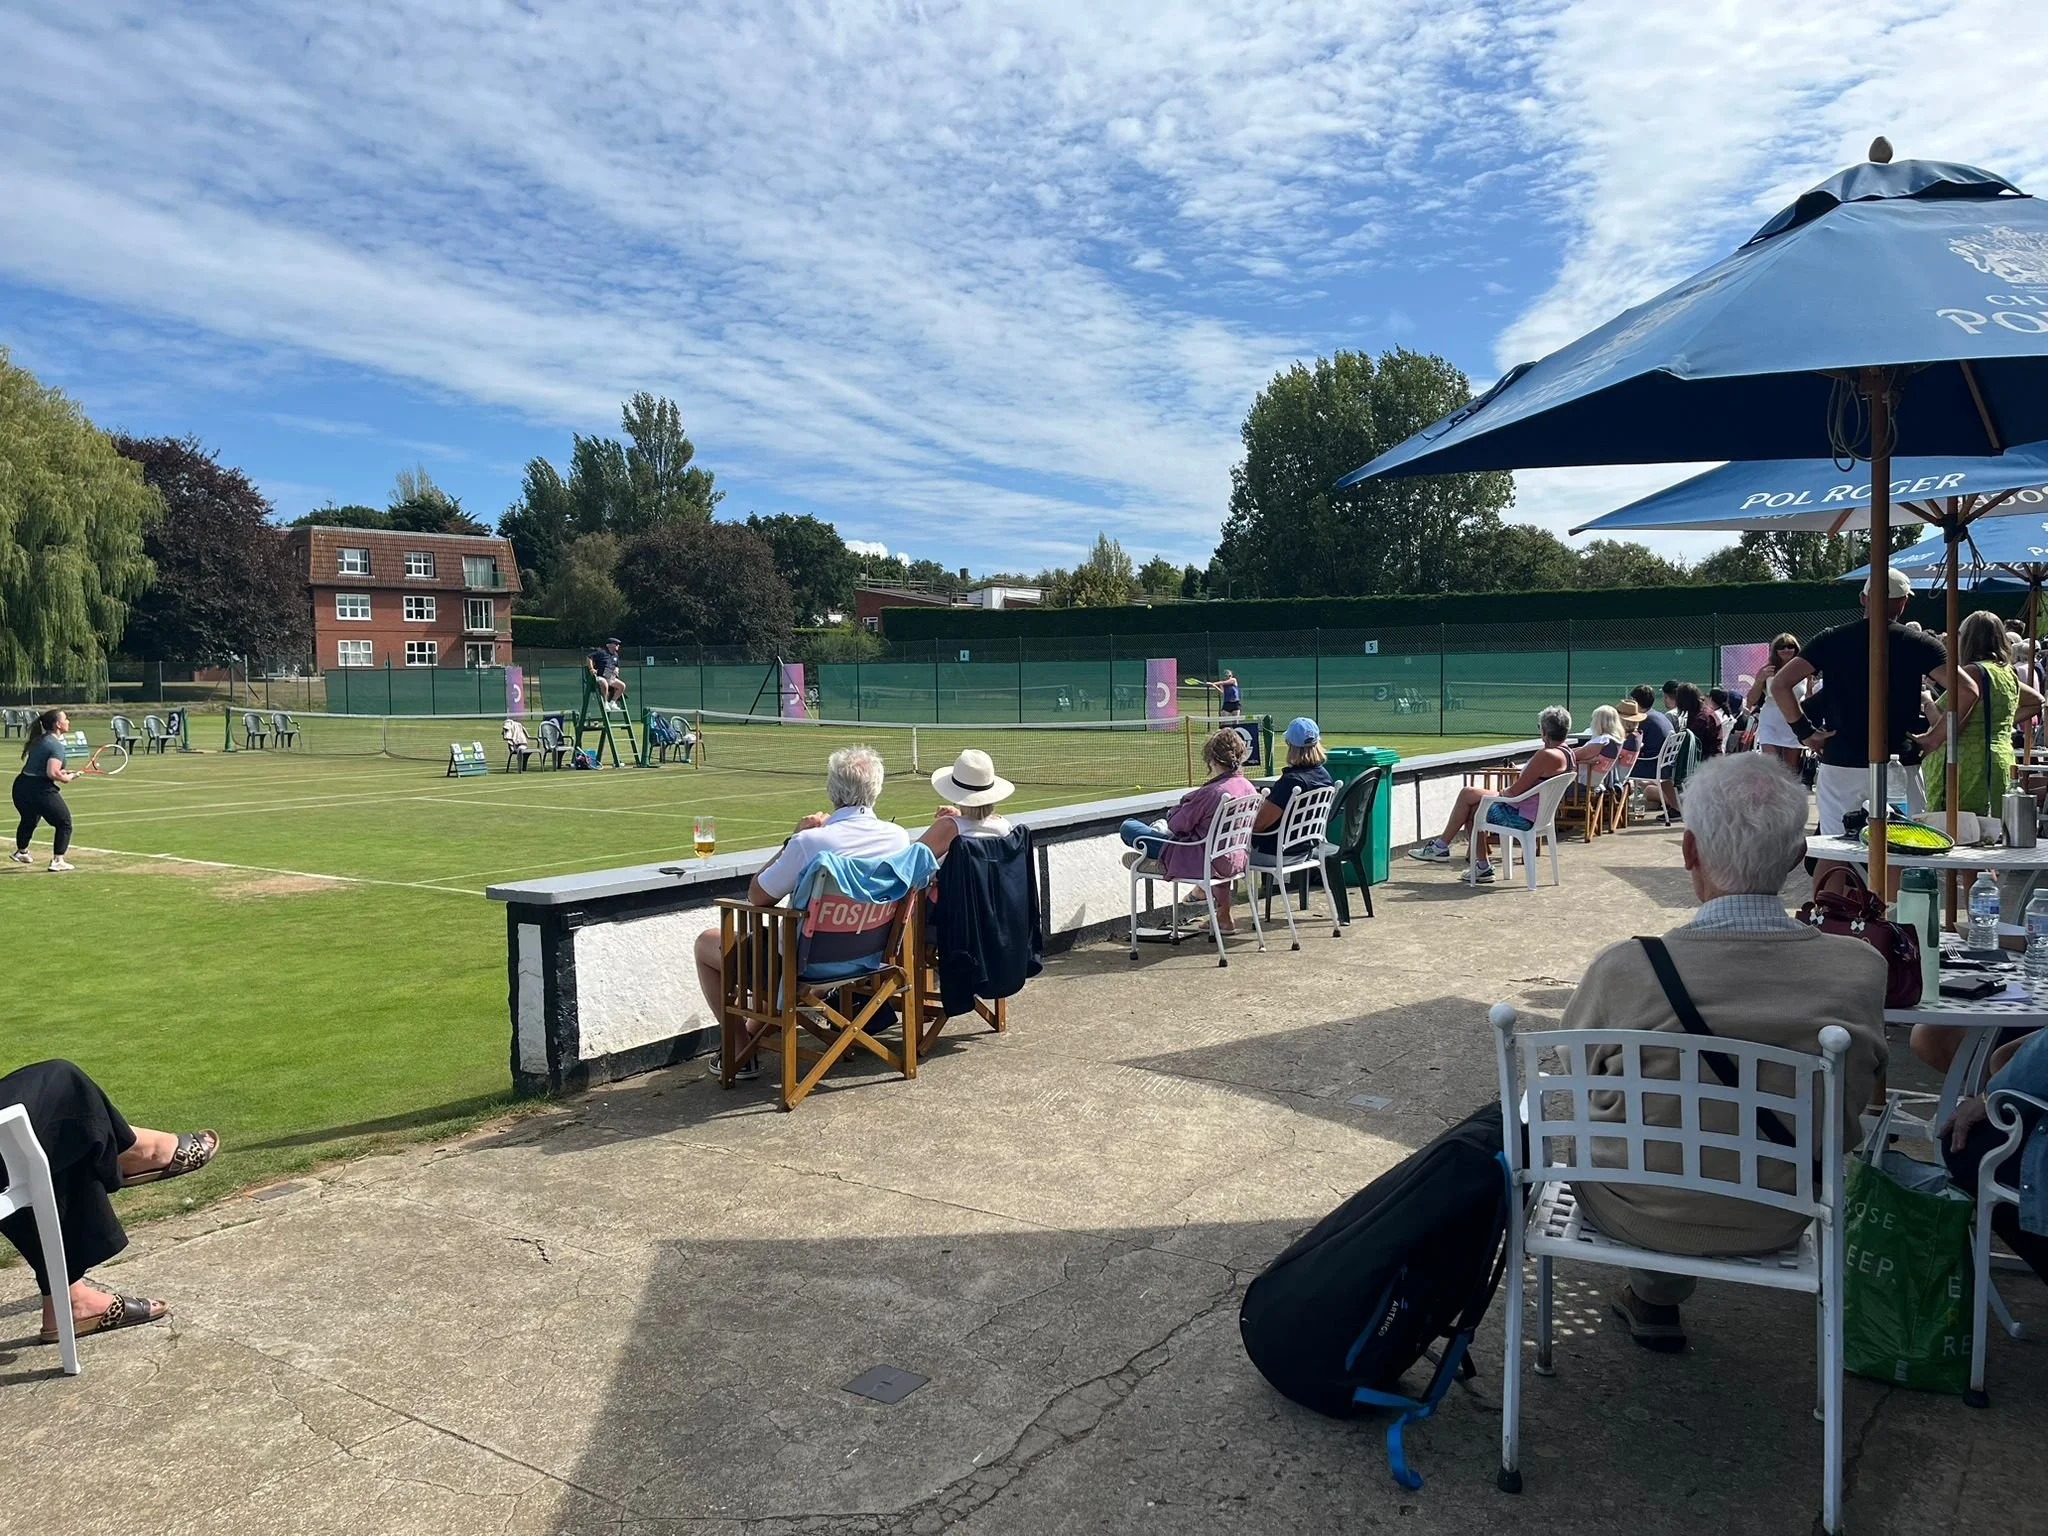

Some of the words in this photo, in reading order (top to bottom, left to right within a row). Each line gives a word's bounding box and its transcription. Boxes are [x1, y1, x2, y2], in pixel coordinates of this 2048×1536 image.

[1936, 309, 2048, 334] PO
[1739, 490, 1812, 510] POL
[1821, 472, 1967, 503] ROGER
[1378, 1299, 1400, 1337] ARTENGO
